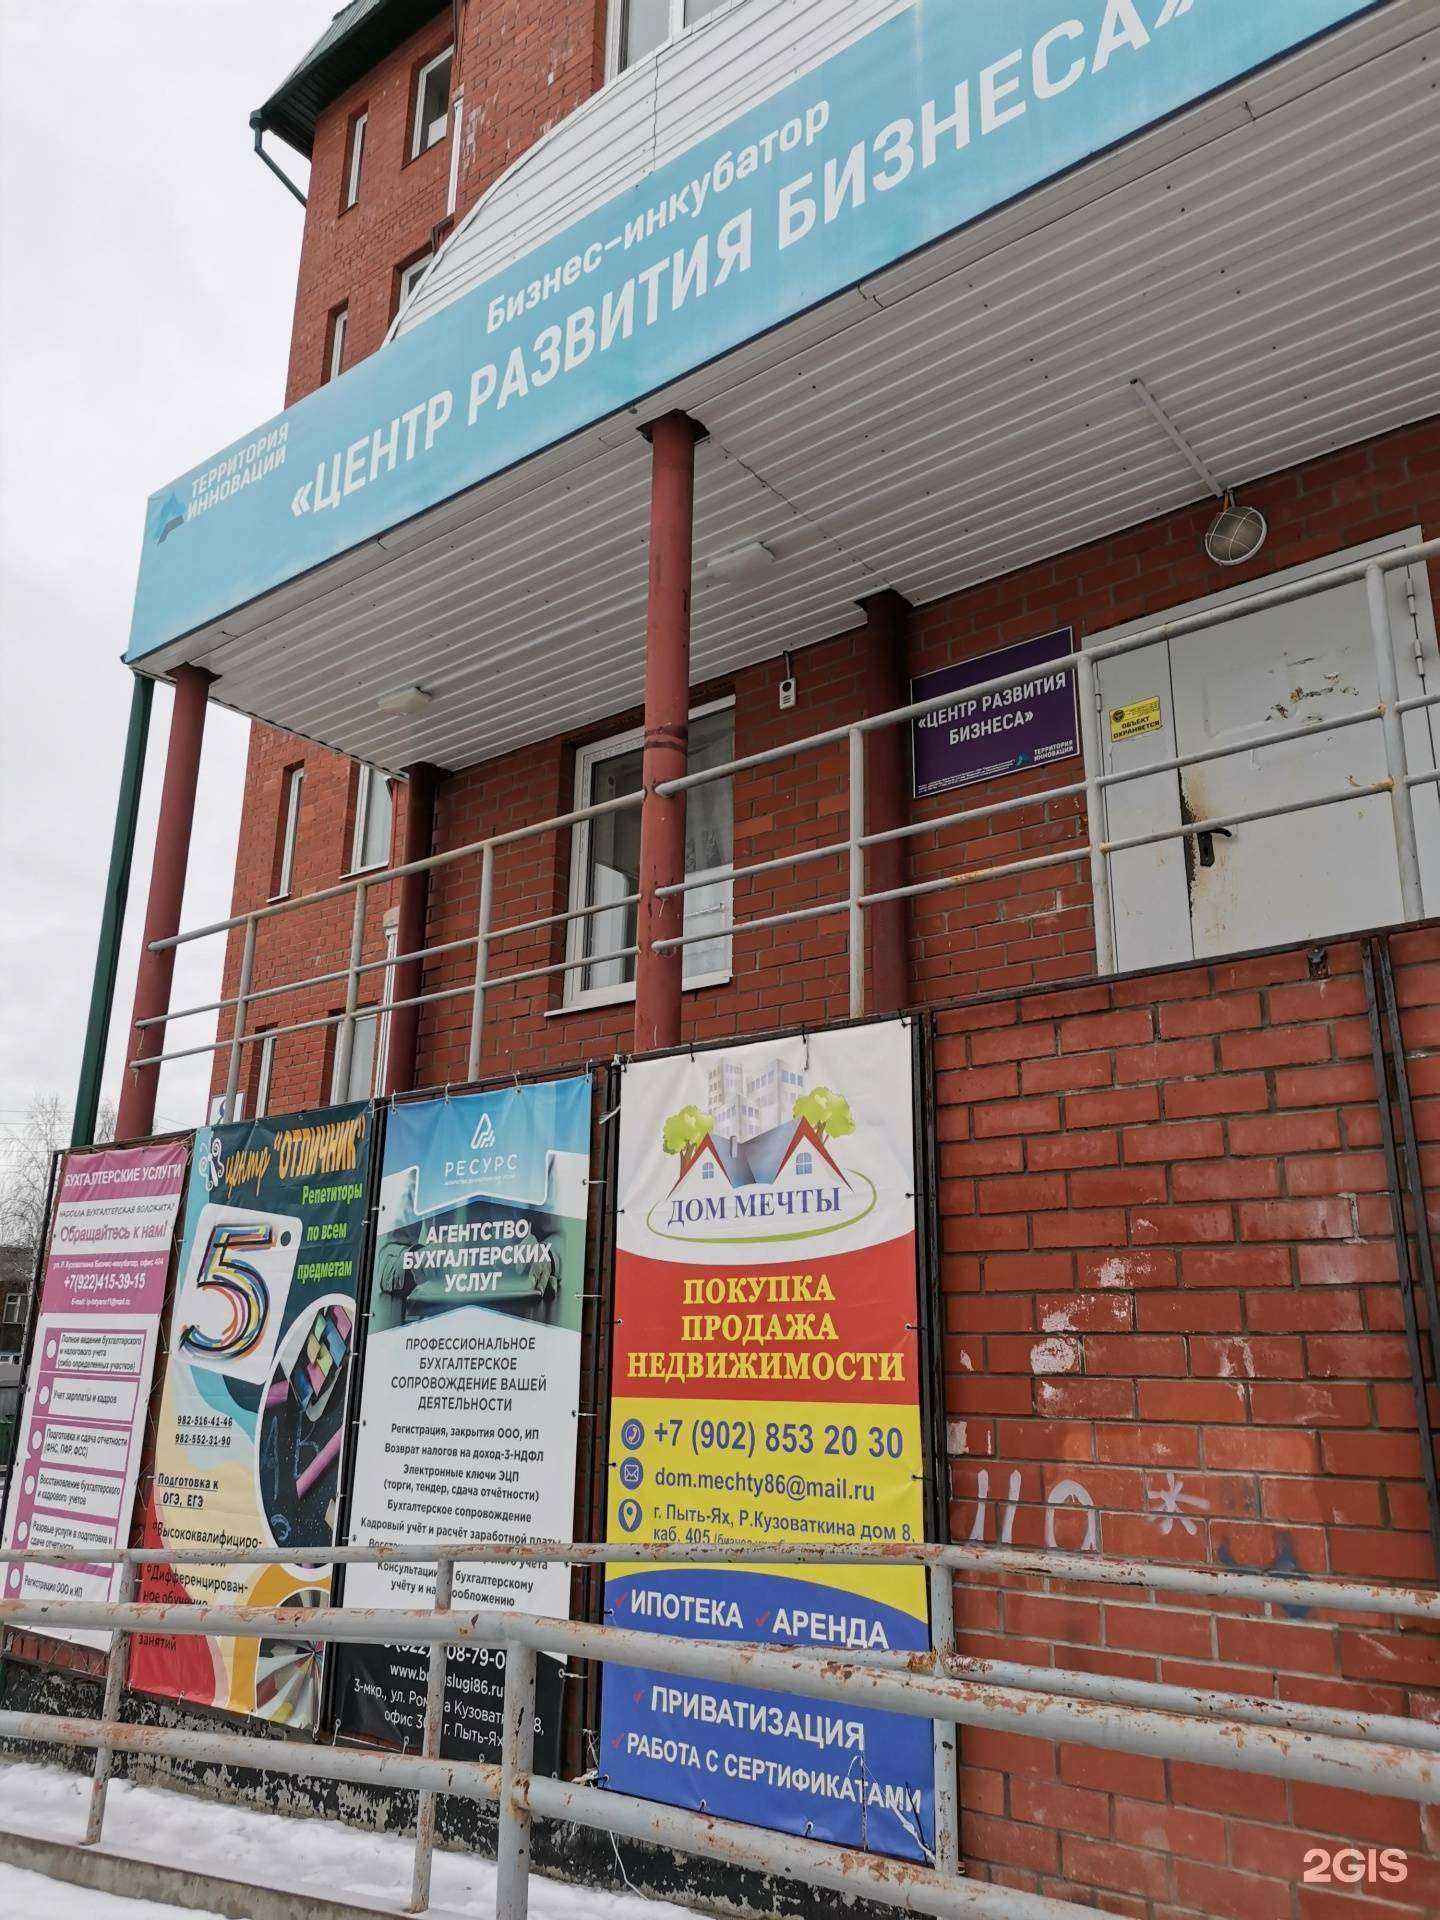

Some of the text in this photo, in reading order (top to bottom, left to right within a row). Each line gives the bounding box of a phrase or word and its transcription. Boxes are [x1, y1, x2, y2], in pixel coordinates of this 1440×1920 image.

[487, 100, 829, 334] Бизнес-инкубатор
[290, 390, 453, 517] «ЦЕНТР
[468, 208, 752, 426] РАЗВИТИЯ
[192, 422, 289, 498] ТЕРРИТОРИЯ
[918, 671, 1067, 729] «ЦЕНТР РАЗВИТИЯ
[949, 710, 1034, 745] БИЗНЕСА»
[1113, 720, 1160, 739] ОХРАНЯЕТСЯ
[1121, 716, 1149, 729] ОБЪЕКТ
[1034, 740, 1073, 755] ТЕРРИТОРИЯ
[64, 1164, 181, 1187] БУХГАЛТЕРСКИЕ УСЛУГИ
[445, 1154, 519, 1177] РЕСУРС
[302, 1183, 362, 1206] Репетиторы
[667, 1187, 841, 1228] ДОМ МЕЧТЫ
[60, 1221, 168, 1245] Обращайтесь к нам!
[307, 1222, 347, 1241] по всем
[426, 1218, 530, 1244] АГЕНТСТВО
[403, 1242, 553, 1270] БУХГАЛТЕРСКИХ
[64, 1272, 146, 1293] +7(922)415-39-15
[297, 1260, 353, 1285] предметам
[444, 1272, 503, 1292] УСЛУГ
[683, 1273, 836, 1306] ПОКУПКА
[62, 1334, 80, 1344] Полное
[102, 1335, 142, 1347] бухгалтерского
[681, 1312, 839, 1347] ПРОДАЖА
[406, 1337, 536, 1350] ПРОФЕССИОНАЛЬНОЕ
[419, 1357, 517, 1370] БУХГАЛТЕРСКОЕ
[627, 1351, 905, 1384] НЕДВИЖИМОСТИ
[391, 1374, 547, 1392] СОПРОВОЖДЕНИЕ ВАШЕЙ
[66, 1392, 92, 1403] зарплаты
[97, 1395, 117, 1404] кадров
[418, 1396, 512, 1411] ДЕЯТЕЛЬНОСТИ
[47, 1428, 76, 1441] Подготовка
[81, 1434, 96, 1444] сдача
[175, 1433, 231, 1446] 982-552-31-90
[391, 1423, 539, 1440] Регистрация, закрытия ООО, ИП
[653, 1419, 903, 1459] +7 (902) 853 20 30
[384, 1443, 544, 1463] Возврат налогов на доход-3-НДФЛ
[40, 1474, 121, 1496] Восстановление бухгалтерского
[158, 1473, 219, 1490] Подготовка к
[403, 1464, 519, 1484] Электронные ключи ЭЦП
[655, 1467, 875, 1501] dom.mechty86@mail.ru
[162, 1492, 203, 1508] ОГЭ, ЕГЭ
[383, 1478, 539, 1502] (торги, тендер, сдача отчётности)
[387, 1499, 531, 1523] Бухгалтерское сопровождение
[654, 1507, 662, 1519] г.
[666, 1504, 734, 1526] Пыть-Ях,
[860, 1523, 896, 1541] дом
[32, 1520, 55, 1534] Разовые
[54, 1526, 72, 1539] услуги
[77, 1531, 108, 1545] подготовке
[361, 1516, 404, 1531] Кадровый
[407, 1520, 426, 1534] учёт
[436, 1526, 467, 1539] расчёт
[470, 1529, 526, 1545] заработной
[653, 1526, 681, 1542] каб.
[685, 1527, 710, 1543] 405
[24, 1575, 56, 1591] Регистрация
[56, 1583, 69, 1594] ООО
[74, 1587, 83, 1598] ИП
[151, 1565, 248, 1594] Дифференцирован-
[391, 1580, 415, 1593] учёту
[455, 1570, 533, 1592] бухгалтерскому
[631, 1588, 889, 1650] ИПОТЕКА АРЕНДА
[390, 1689, 405, 1703] ул.
[384, 1709, 413, 1727] офис
[444, 1723, 451, 1735] г.
[651, 1685, 864, 1751] ПРИВАТИЗАЦИЯ
[627, 1732, 921, 1814] РАБОТА С СЕРТИФИКАТАМИ
